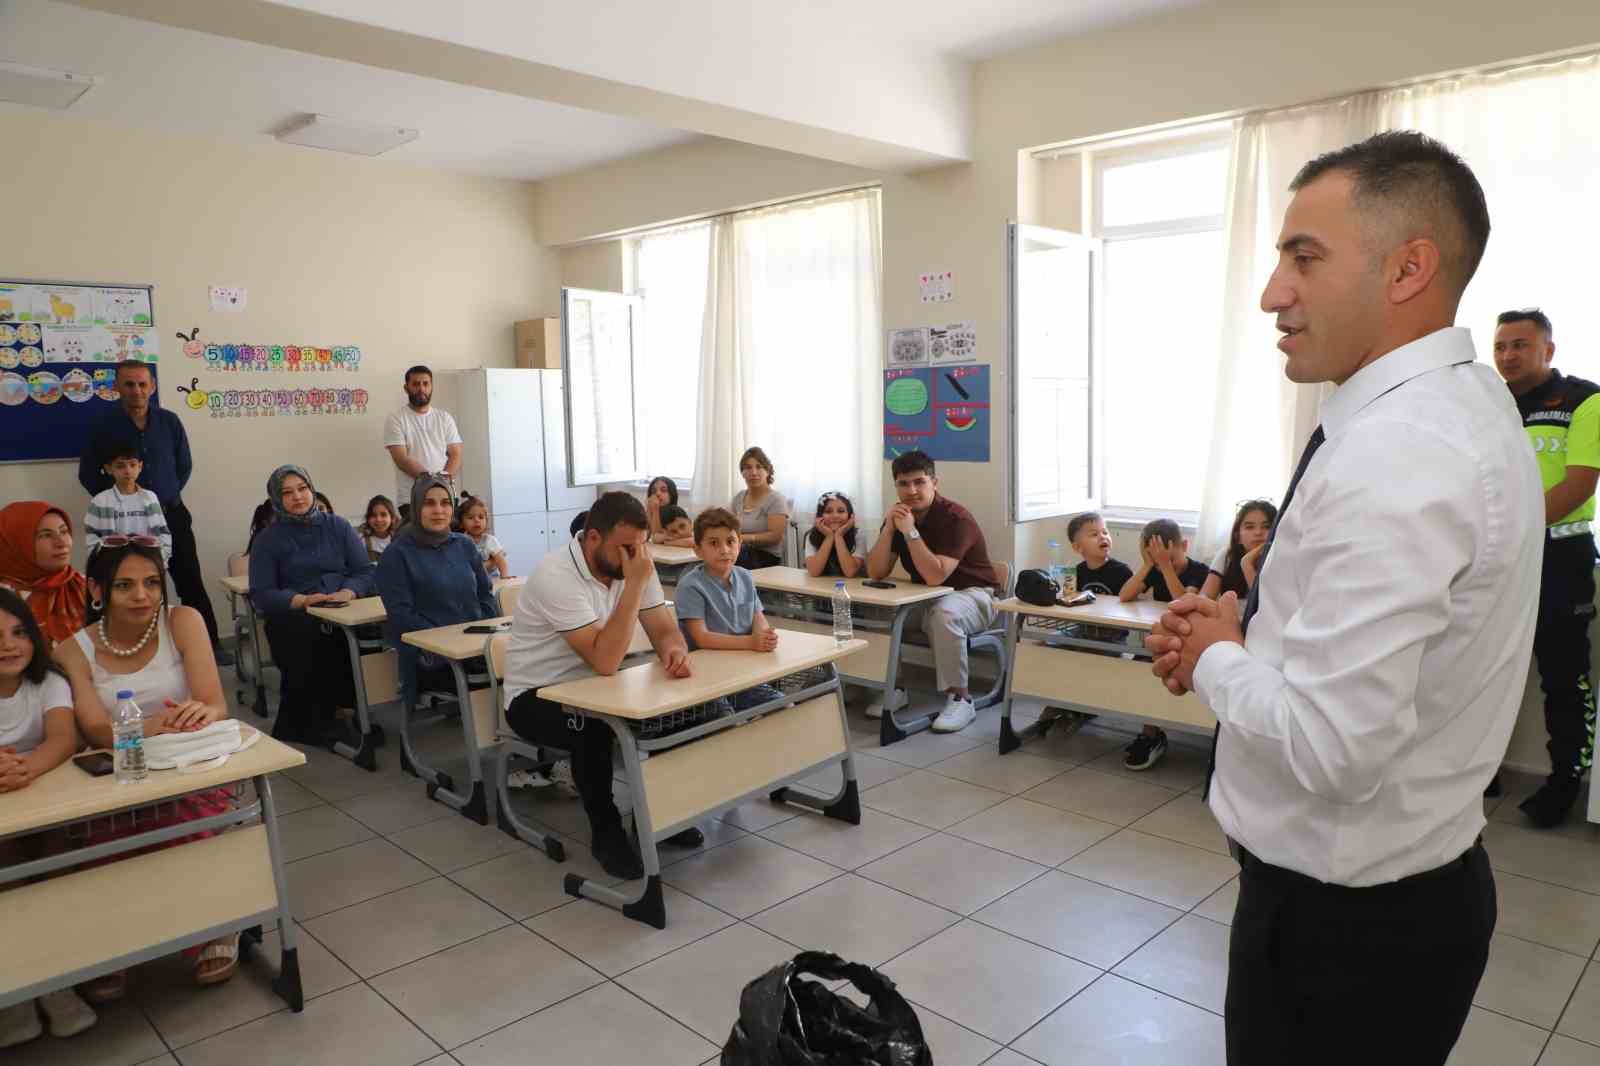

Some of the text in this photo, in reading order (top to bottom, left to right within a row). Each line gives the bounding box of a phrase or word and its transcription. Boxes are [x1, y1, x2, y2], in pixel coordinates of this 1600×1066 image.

[208, 348, 218, 360] 5
[271, 349, 281, 361] 25
[210, 395, 221, 408] 10
[229, 393, 239, 405] 20
[245, 393, 255, 406] 30
[262, 393, 272, 406] 40
